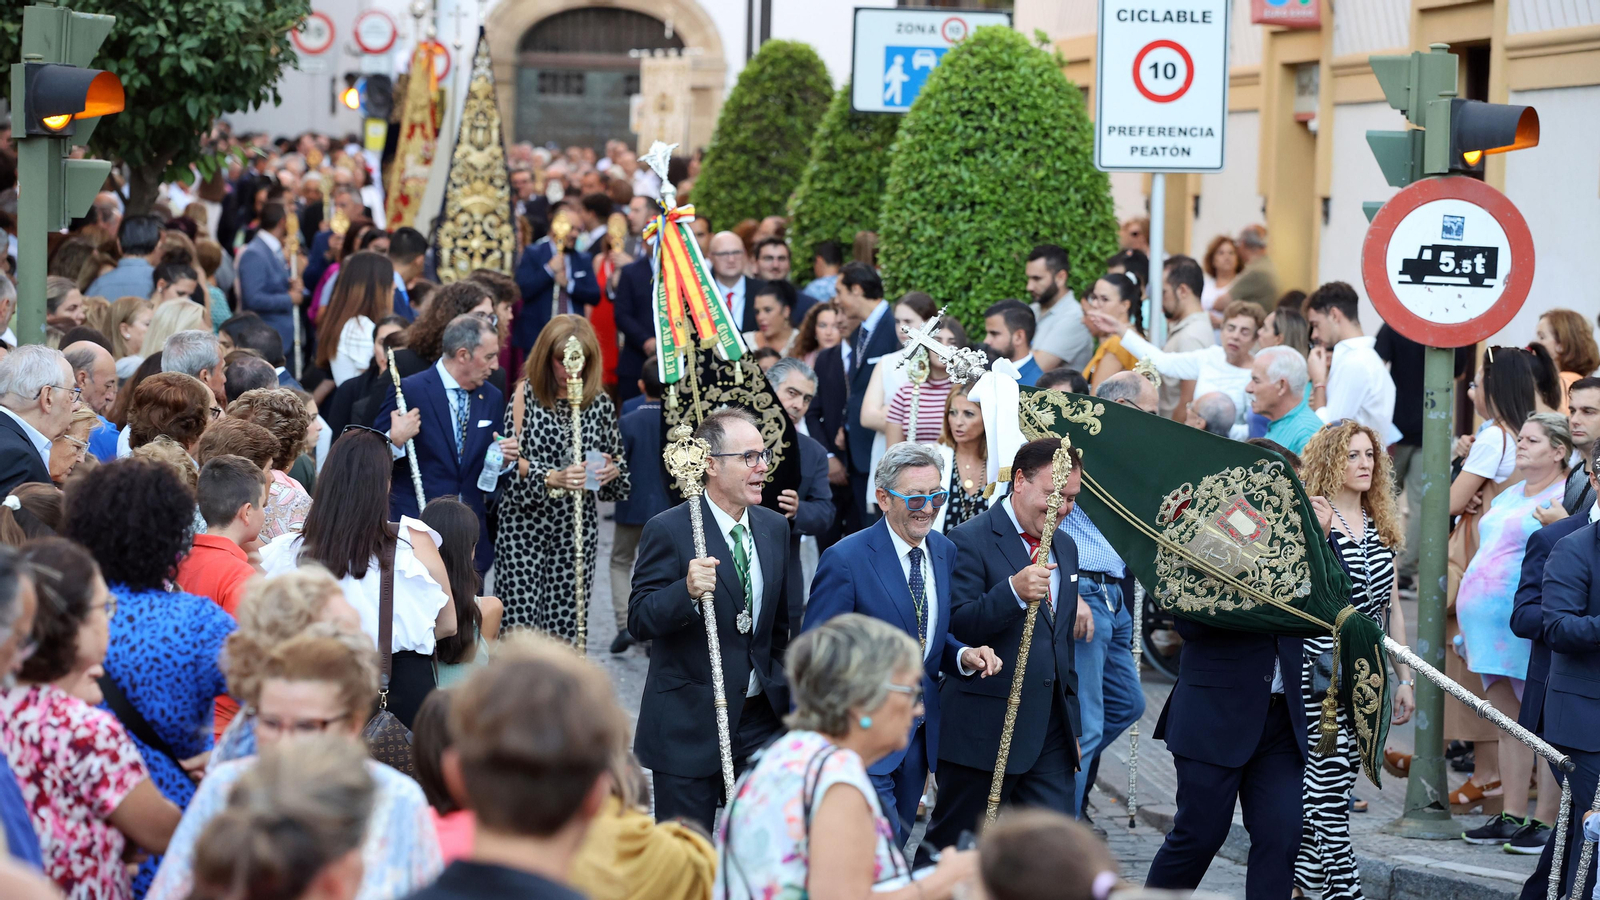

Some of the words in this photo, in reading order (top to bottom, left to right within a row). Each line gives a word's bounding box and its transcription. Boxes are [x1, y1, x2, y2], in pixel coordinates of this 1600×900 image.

[1116, 9, 1213, 24] CICLABLE
[896, 23, 937, 34] ZONA
[1148, 62, 1177, 80] 10
[1107, 126, 1215, 138] PREFERENCIA
[1130, 144, 1191, 157] PEATÓN
[716, 322, 735, 348] Civil
[664, 350, 676, 375] 1938
